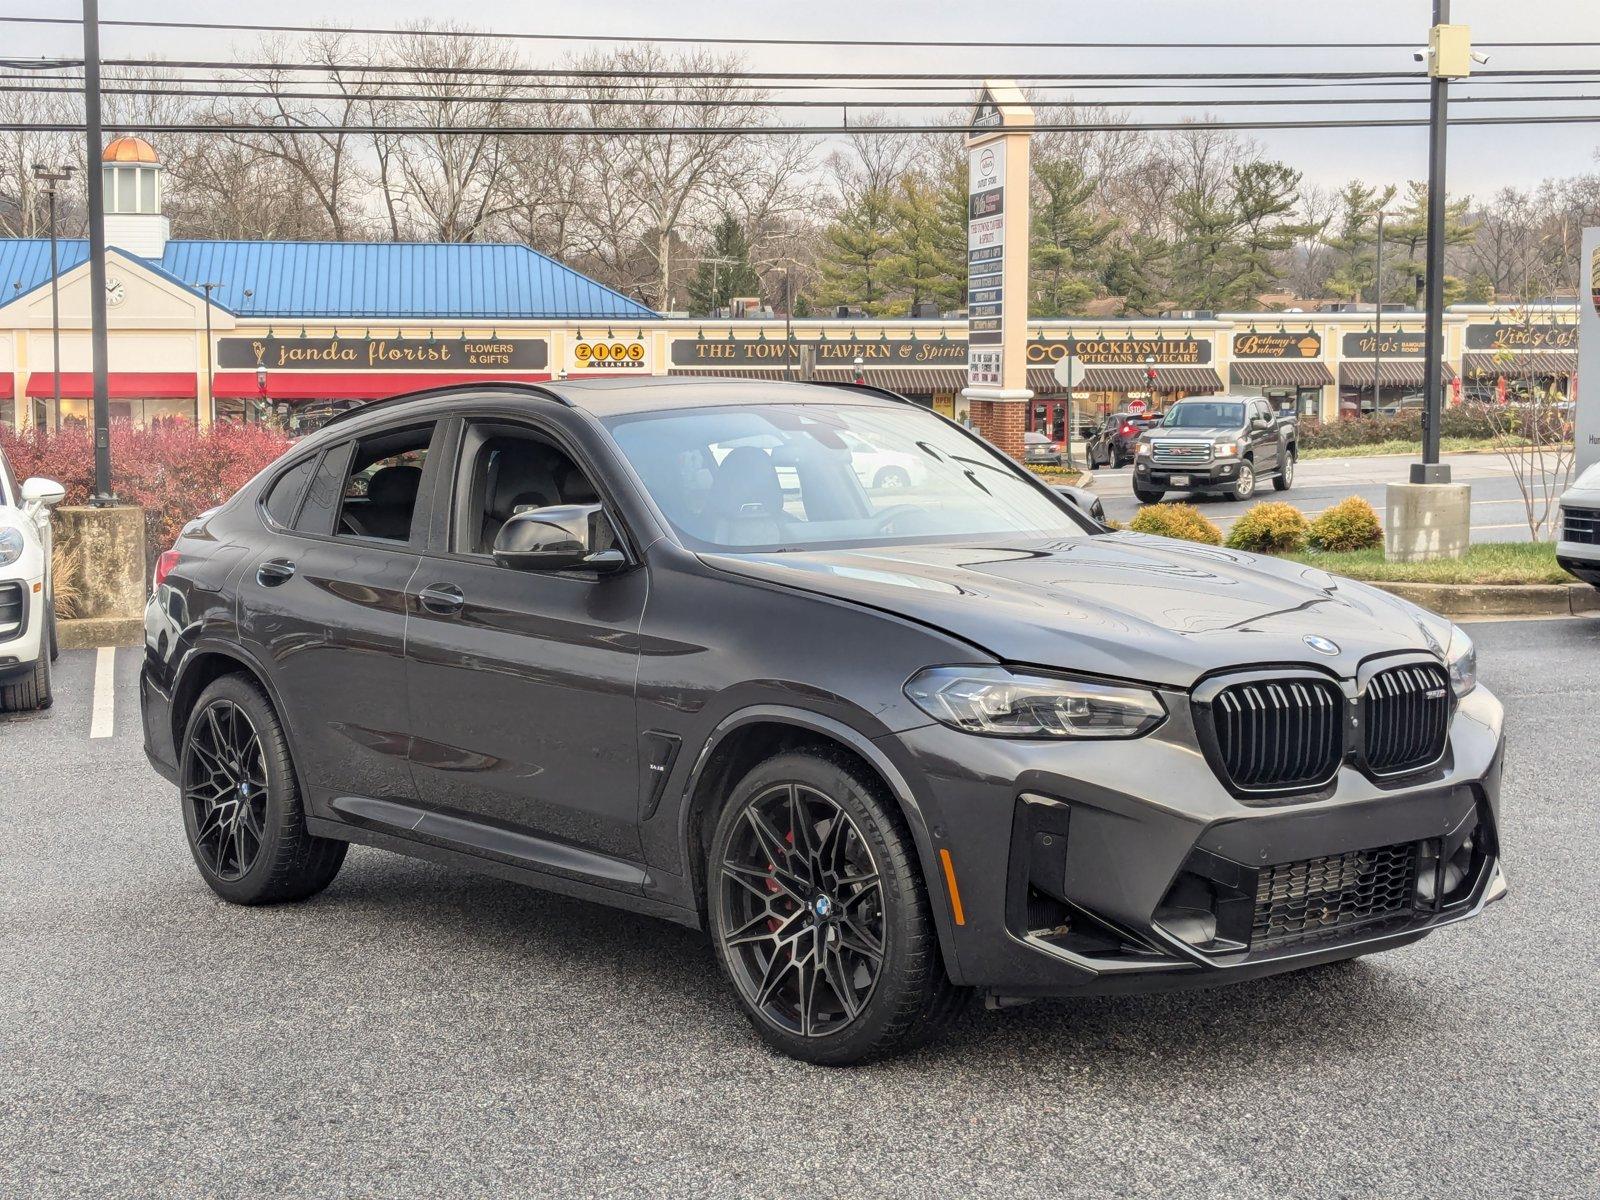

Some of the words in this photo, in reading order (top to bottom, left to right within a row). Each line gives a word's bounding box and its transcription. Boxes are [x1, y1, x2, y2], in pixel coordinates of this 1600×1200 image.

[1546, 328, 1577, 346] Caf
[278, 341, 358, 367] janda
[368, 341, 451, 367] florist
[464, 344, 514, 353] FLOWERS
[578, 345, 641, 358] ZIPS
[696, 344, 736, 358] THE
[743, 344, 808, 358] TOWN
[820, 344, 892, 358] TAVERN
[899, 344, 913, 358] &
[915, 343, 965, 361] Spirits
[1076, 341, 1198, 354] COCKEYSVILLE
[469, 355, 477, 364] &
[478, 355, 509, 364] GIFTS
[1136, 354, 1144, 363] &
[1146, 354, 1198, 363] YECARE
